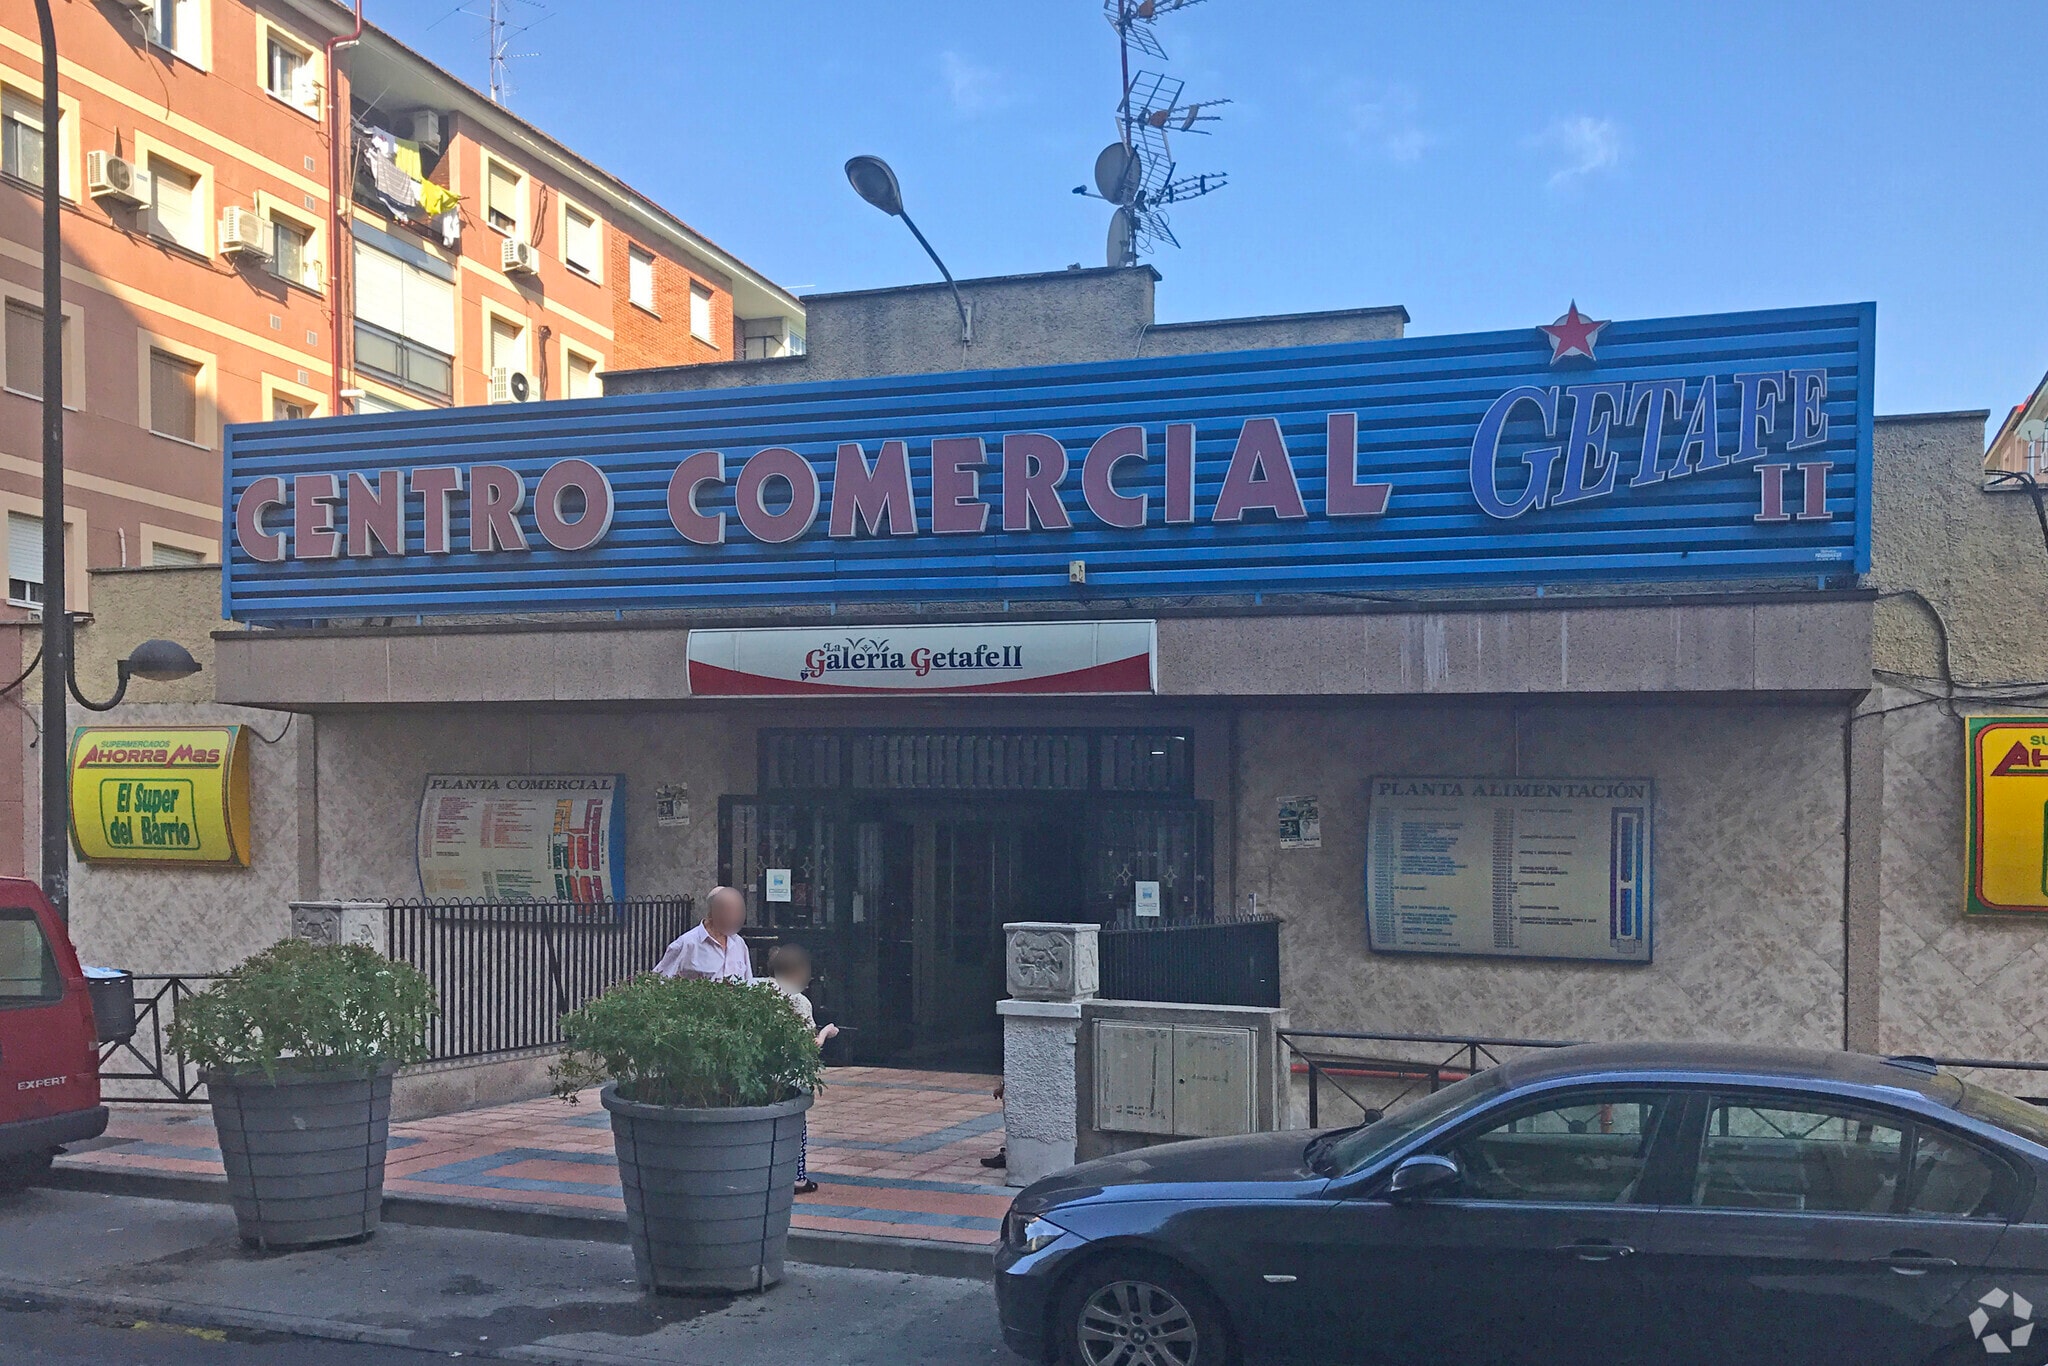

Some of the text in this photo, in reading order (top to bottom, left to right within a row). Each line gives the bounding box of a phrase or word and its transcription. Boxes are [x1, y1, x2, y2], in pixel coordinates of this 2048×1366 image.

[1469, 368, 1829, 519] GETAFE
[236, 411, 1393, 562] CENTRO COMERCIAL
[1753, 461, 1834, 521] II
[805, 646, 906, 678] Galería
[100, 740, 171, 748] SUPERMERCADOS
[430, 779, 612, 790] PLANTA COMERCIAL
[1377, 781, 1646, 799] PLANTA ALIMENTACIÓN
[117, 783, 180, 822] El Super
[110, 816, 190, 846] del Barrio
[17, 1075, 67, 1091] EXPERT
